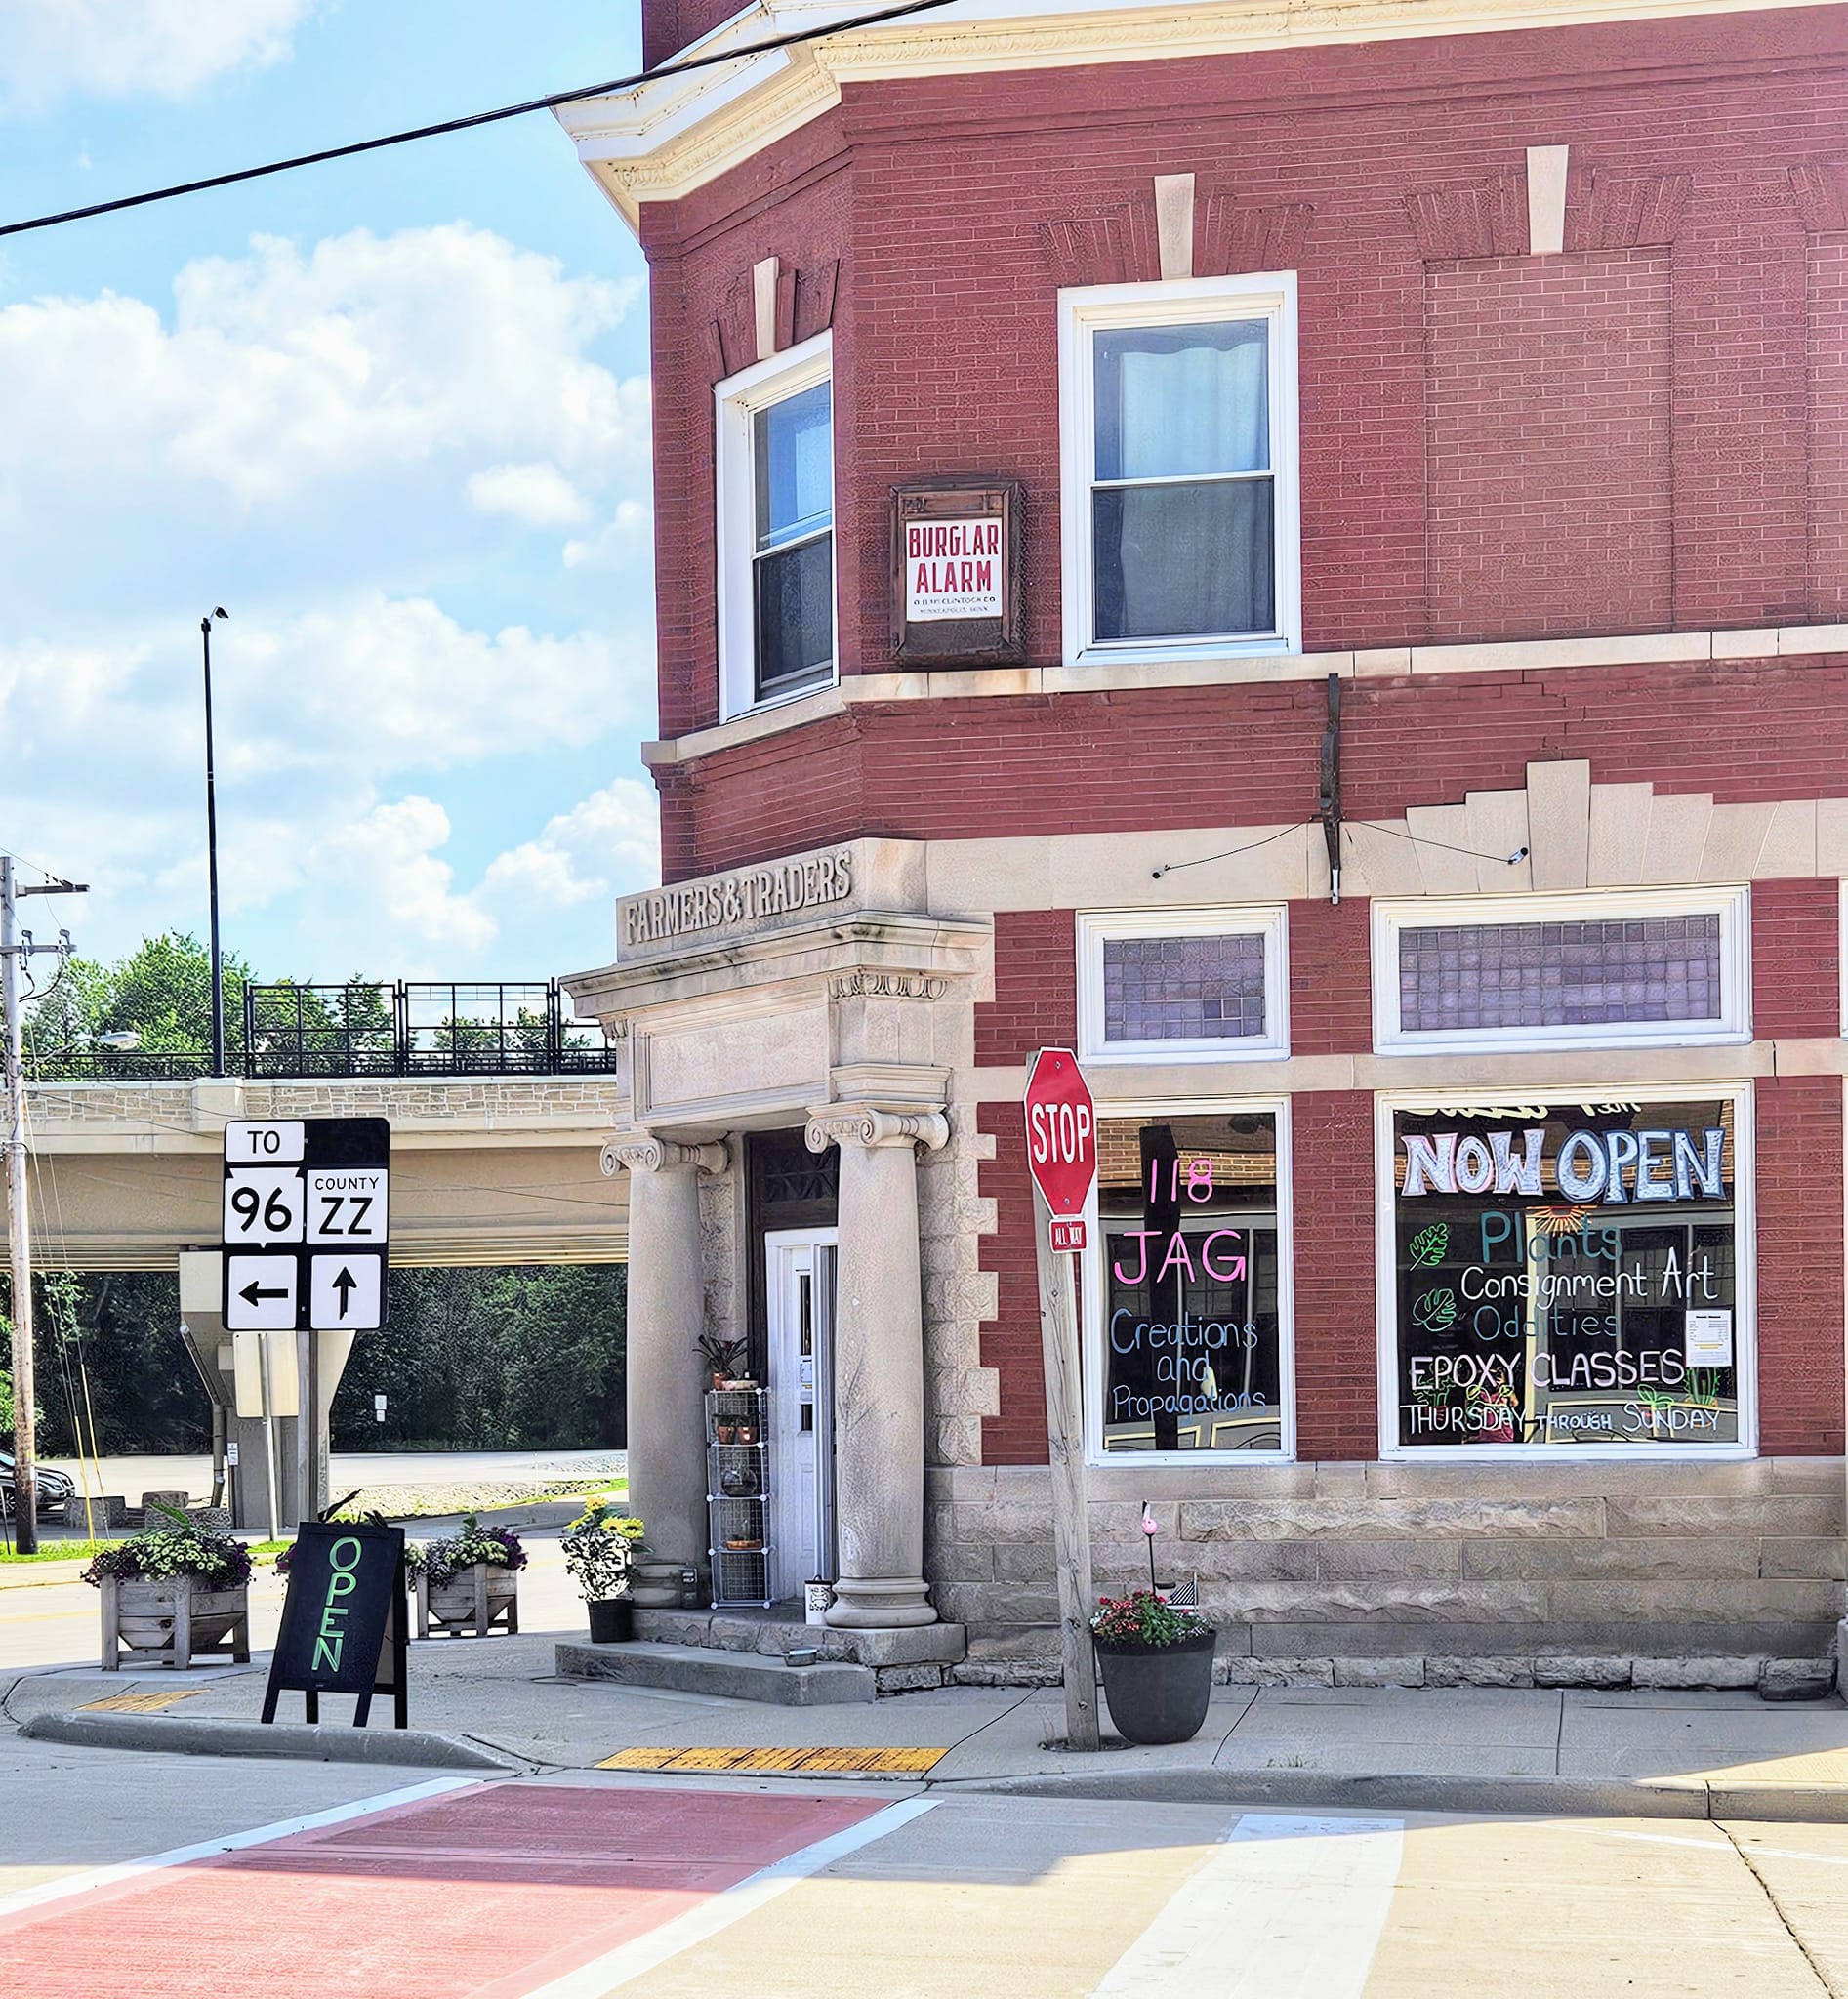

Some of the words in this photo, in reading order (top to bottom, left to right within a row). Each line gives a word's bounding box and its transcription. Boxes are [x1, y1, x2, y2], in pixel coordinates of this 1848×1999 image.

[909, 524, 999, 558] BURGLAR
[916, 560, 991, 594] ALARM
[247, 1130, 280, 1154] TO
[1031, 1102, 1090, 1164] STOP
[314, 1176, 379, 1190] COUNTY
[1150, 1158, 1214, 1203] 118
[1400, 1128, 1545, 1197] NOW
[1555, 1127, 1726, 1204] OPEN
[231, 1187, 292, 1232] 96
[318, 1197, 373, 1235] ZZ
[1055, 1227, 1069, 1245] ALL
[1114, 1230, 1246, 1284] JAG
[1480, 1210, 1623, 1264] Plants
[1461, 1262, 1648, 1311] Consignment
[1661, 1246, 1718, 1299] Art
[1111, 1307, 1258, 1354] Creations
[1157, 1349, 1210, 1382] and
[1411, 1352, 1521, 1390] EPOXY
[1531, 1348, 1686, 1388] CLASSES
[1112, 1384, 1267, 1426] Propagations
[1399, 1404, 1527, 1434] THURSDAY
[1535, 1413, 1612, 1431] THROUGH
[1622, 1403, 1721, 1433] SUNDAY
[311, 1536, 362, 1673] OPEN
